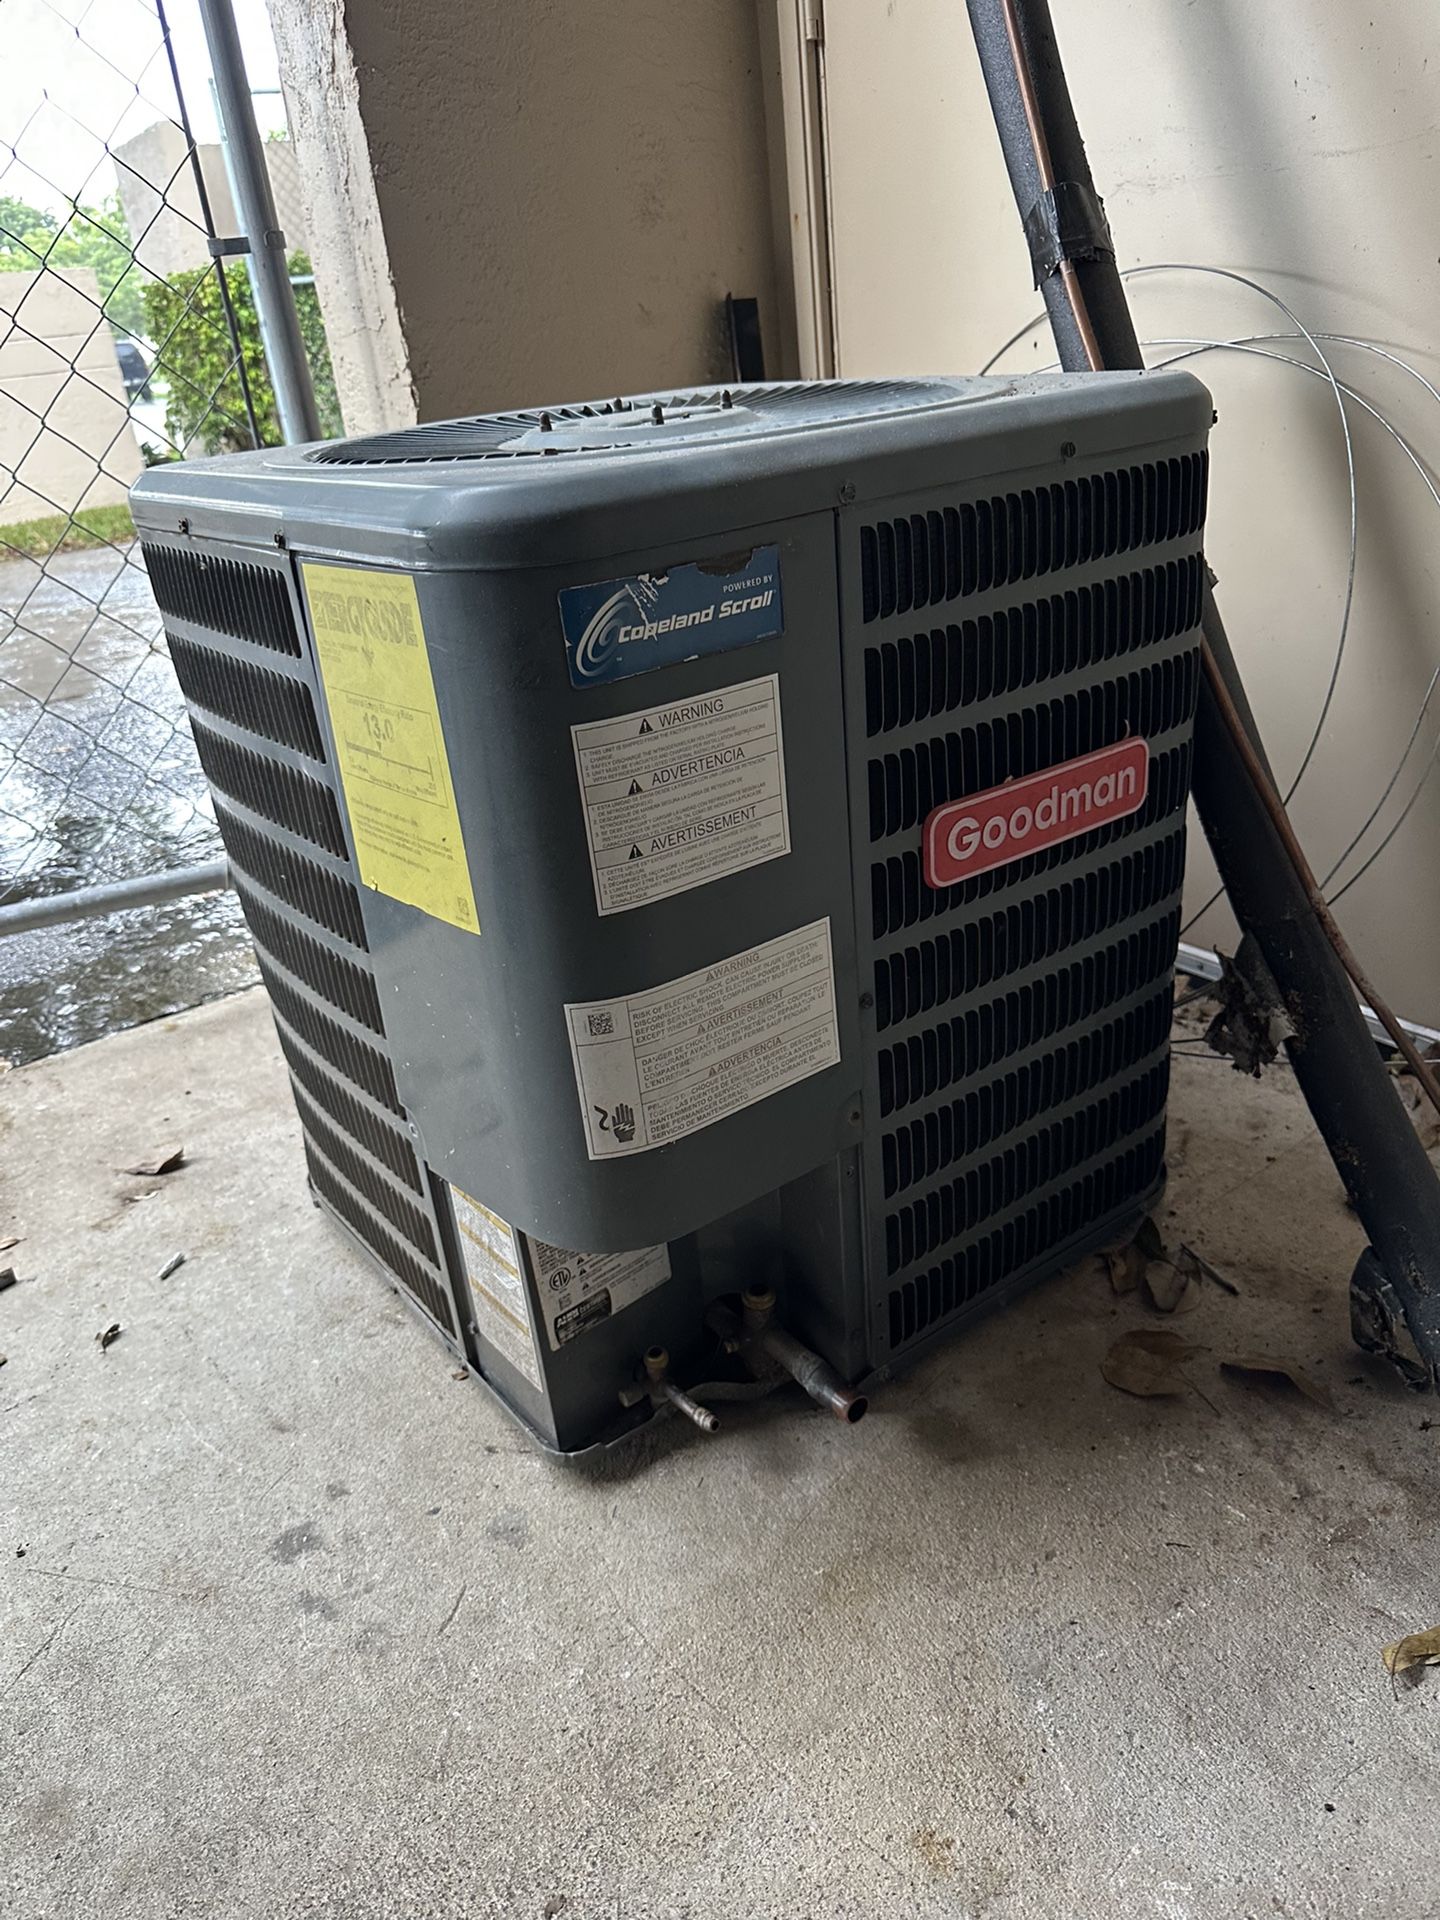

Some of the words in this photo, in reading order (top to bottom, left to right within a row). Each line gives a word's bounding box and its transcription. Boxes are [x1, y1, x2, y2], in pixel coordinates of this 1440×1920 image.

[722, 576, 761, 593] POWERED
[763, 575, 774, 584] BY
[618, 605, 714, 643] Copeland
[718, 590, 773, 618] Scroll
[363, 712, 394, 743] 13.0
[658, 697, 724, 728] WARNING
[649, 746, 745, 786] ADVERTENCIA
[648, 805, 757, 852] AVERTISSEMENT
[947, 765, 1136, 861] Goodman
[712, 951, 760, 979] WARNING
[632, 1008, 650, 1022] RISK
[651, 1004, 662, 1015] OF
[663, 990, 698, 1010] ELECTRIC
[633, 1004, 681, 1030] DISCONNECT
[696, 987, 723, 1005] REMOTE
[706, 987, 784, 1030] AVERTISSEMENT
[634, 1019, 665, 1037] BEFORE
[635, 1027, 665, 1044] EXCEPT
[673, 1044, 684, 1055] DE
[716, 1034, 782, 1072] ADVERTENCIA
